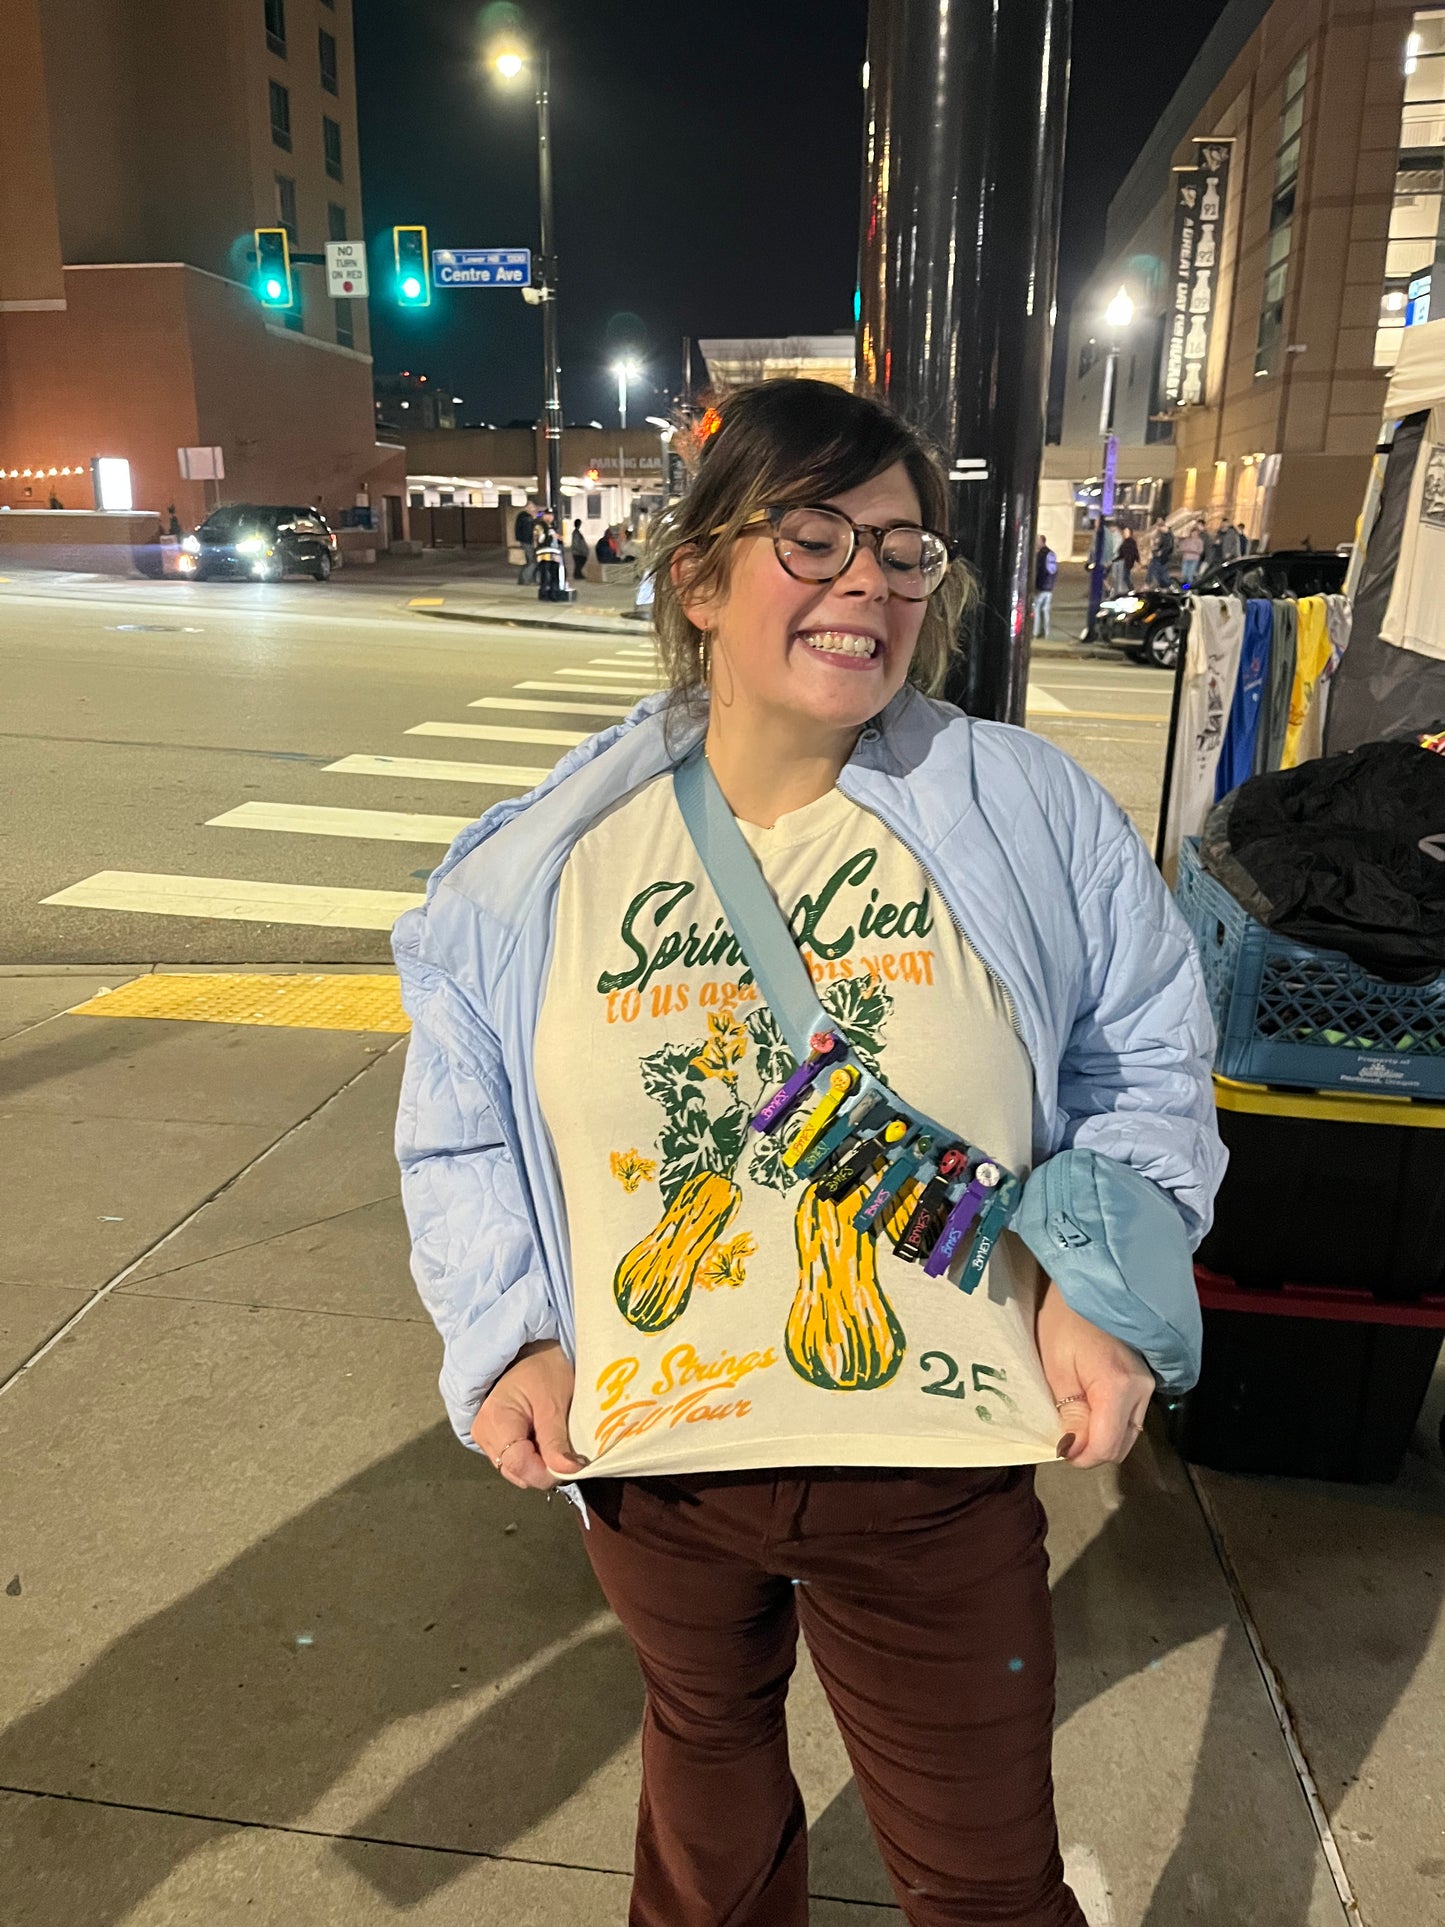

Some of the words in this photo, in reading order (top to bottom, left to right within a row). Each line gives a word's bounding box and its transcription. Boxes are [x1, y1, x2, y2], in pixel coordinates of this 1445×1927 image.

[336, 258, 358, 267] TURN
[337, 246, 353, 256] NO
[331, 270, 344, 279] ON
[346, 270, 362, 279] RED
[441, 267, 490, 282] Centre
[496, 266, 523, 282] Ave
[606, 986, 641, 1024] to
[651, 980, 690, 1018] us
[698, 981, 758, 1011] aga
[801, 950, 854, 984] his
[860, 948, 936, 999] year
[652, 1343, 779, 1395] Strings
[919, 1350, 1018, 1422] 25
[669, 1382, 752, 1430] Tour
